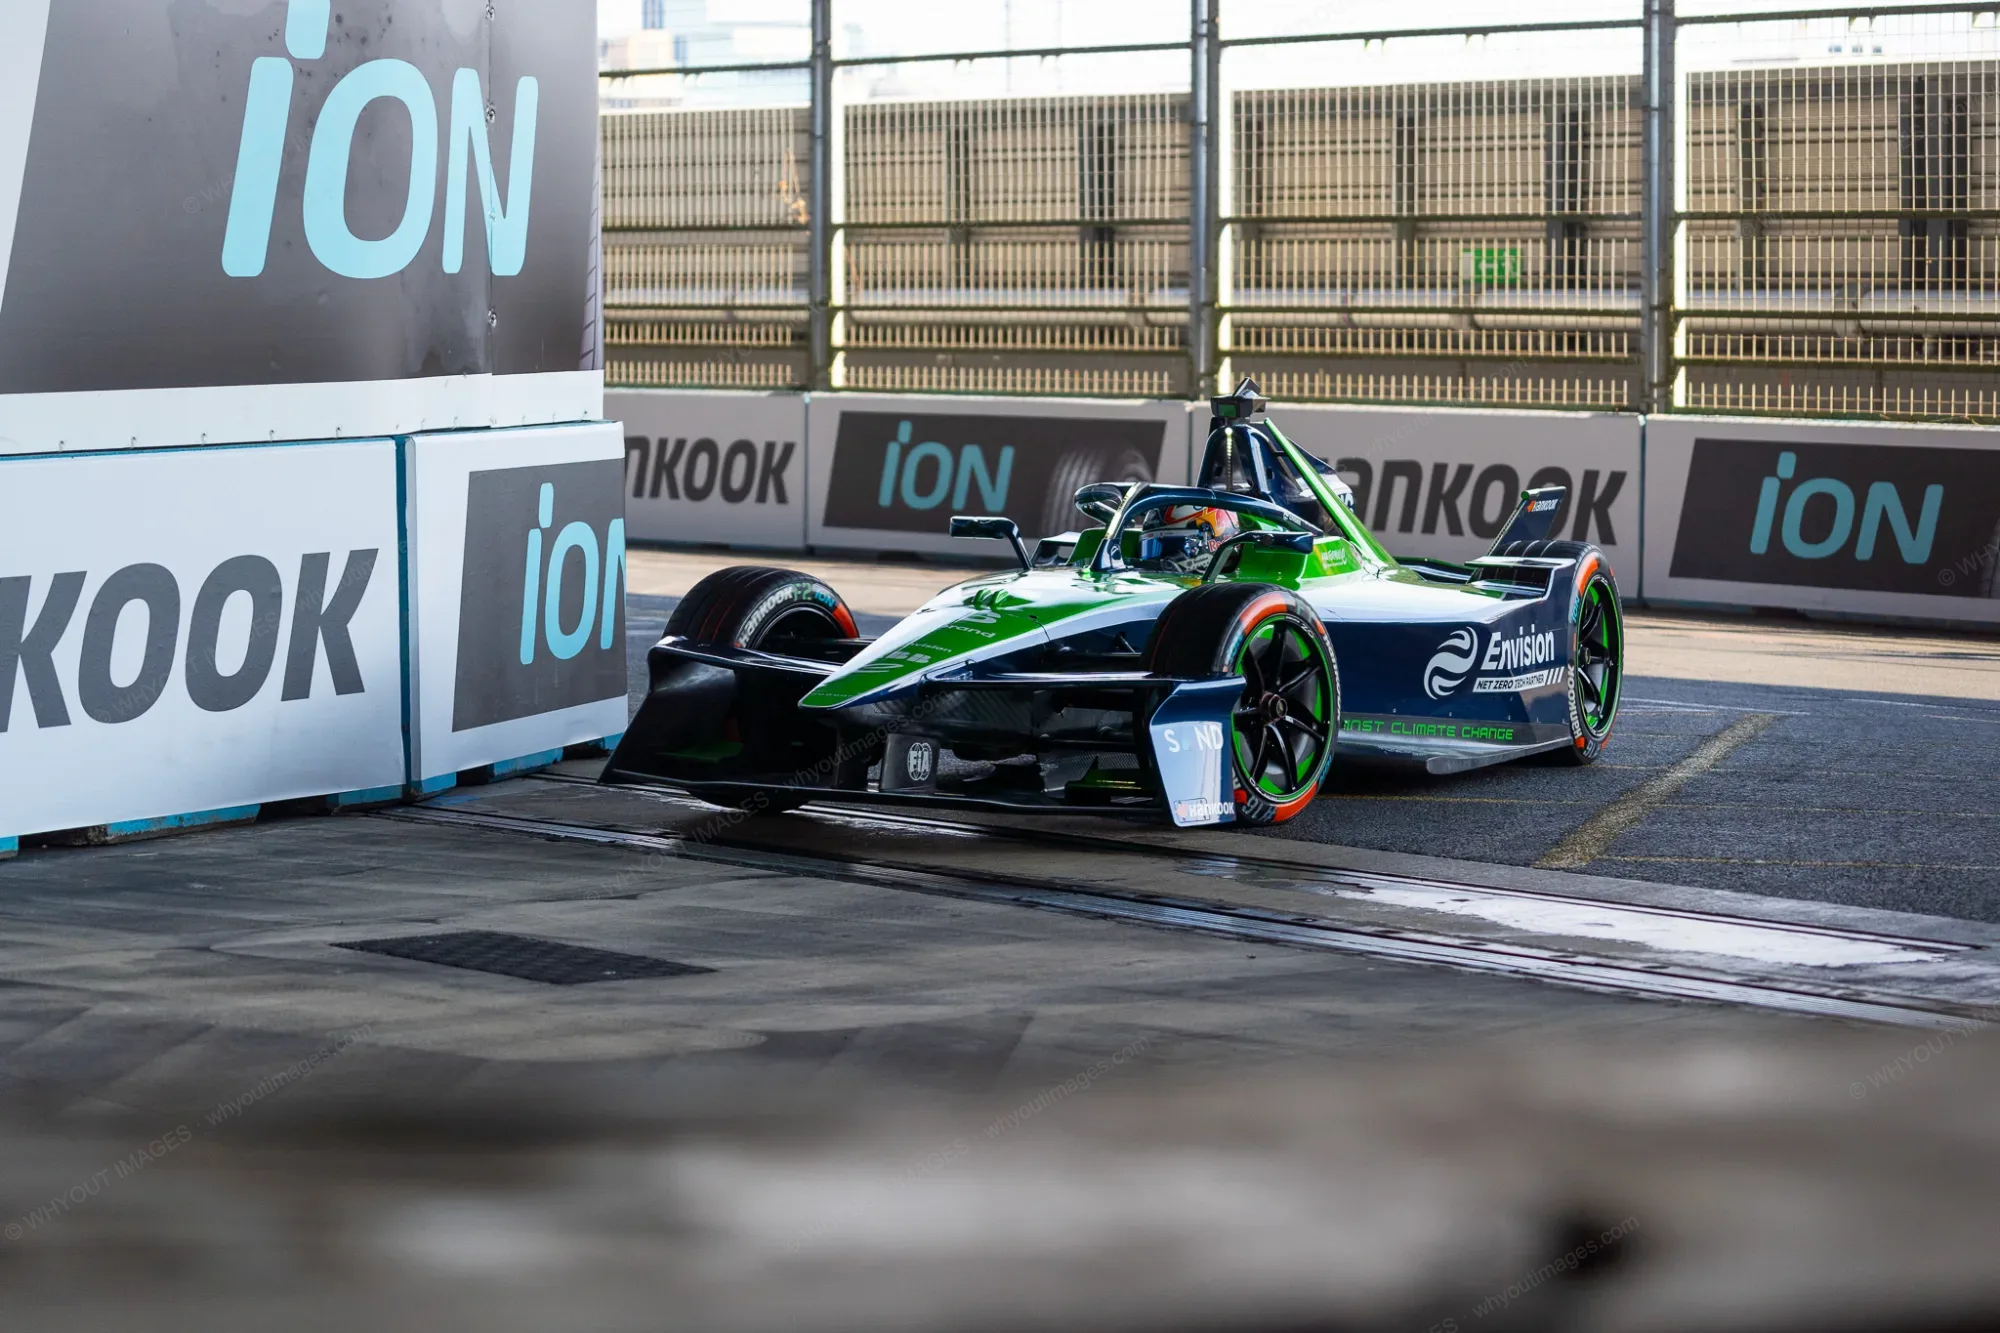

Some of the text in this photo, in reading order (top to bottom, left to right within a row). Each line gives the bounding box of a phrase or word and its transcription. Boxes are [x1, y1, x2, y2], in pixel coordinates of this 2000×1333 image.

[877, 420, 1015, 512] iON
[1750, 451, 1944, 564] iON
[1481, 624, 1554, 670] Envision
[1477, 679, 1493, 690] NET
[1493, 679, 1514, 690] ZERO
[1343, 719, 1515, 741] INST CLIMATE CHANGE
